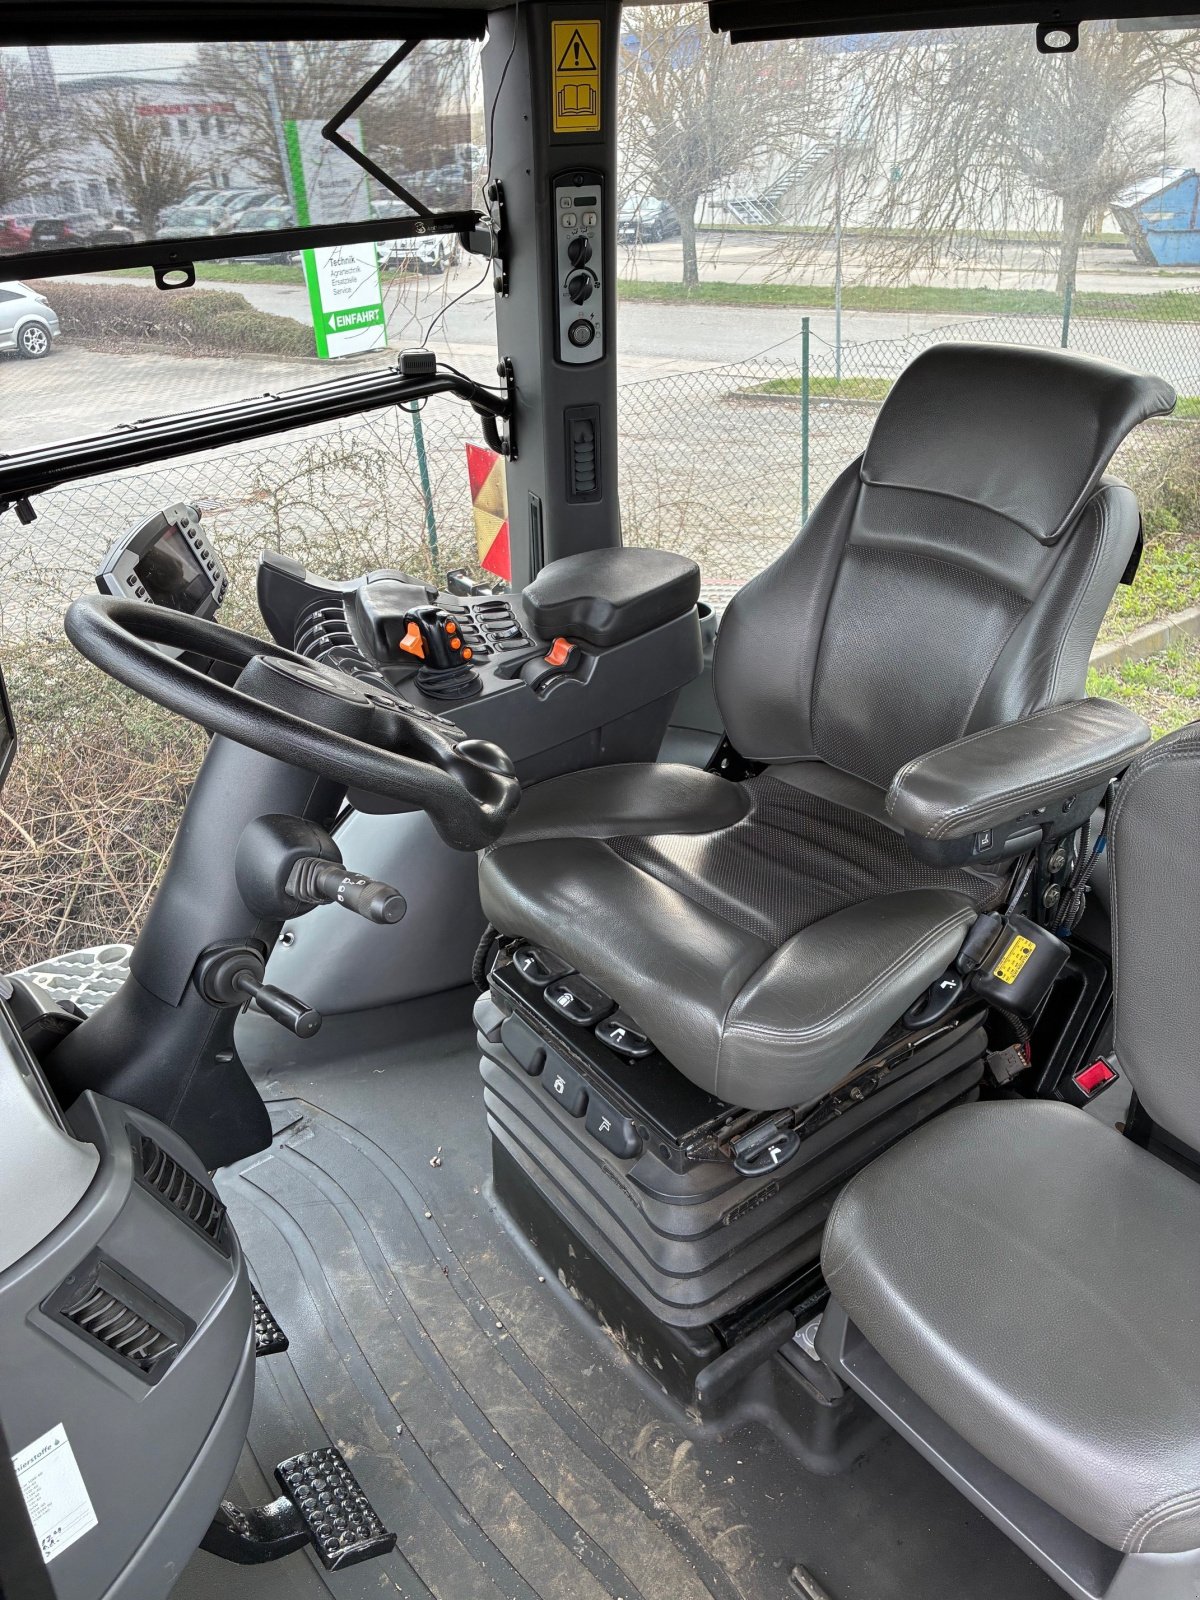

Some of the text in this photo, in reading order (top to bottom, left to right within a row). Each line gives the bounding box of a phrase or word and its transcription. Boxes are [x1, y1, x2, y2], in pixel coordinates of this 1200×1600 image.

[329, 255, 356, 267] Technik
[333, 287, 352, 296] Service
[336, 309, 380, 328] EINFAHRT
